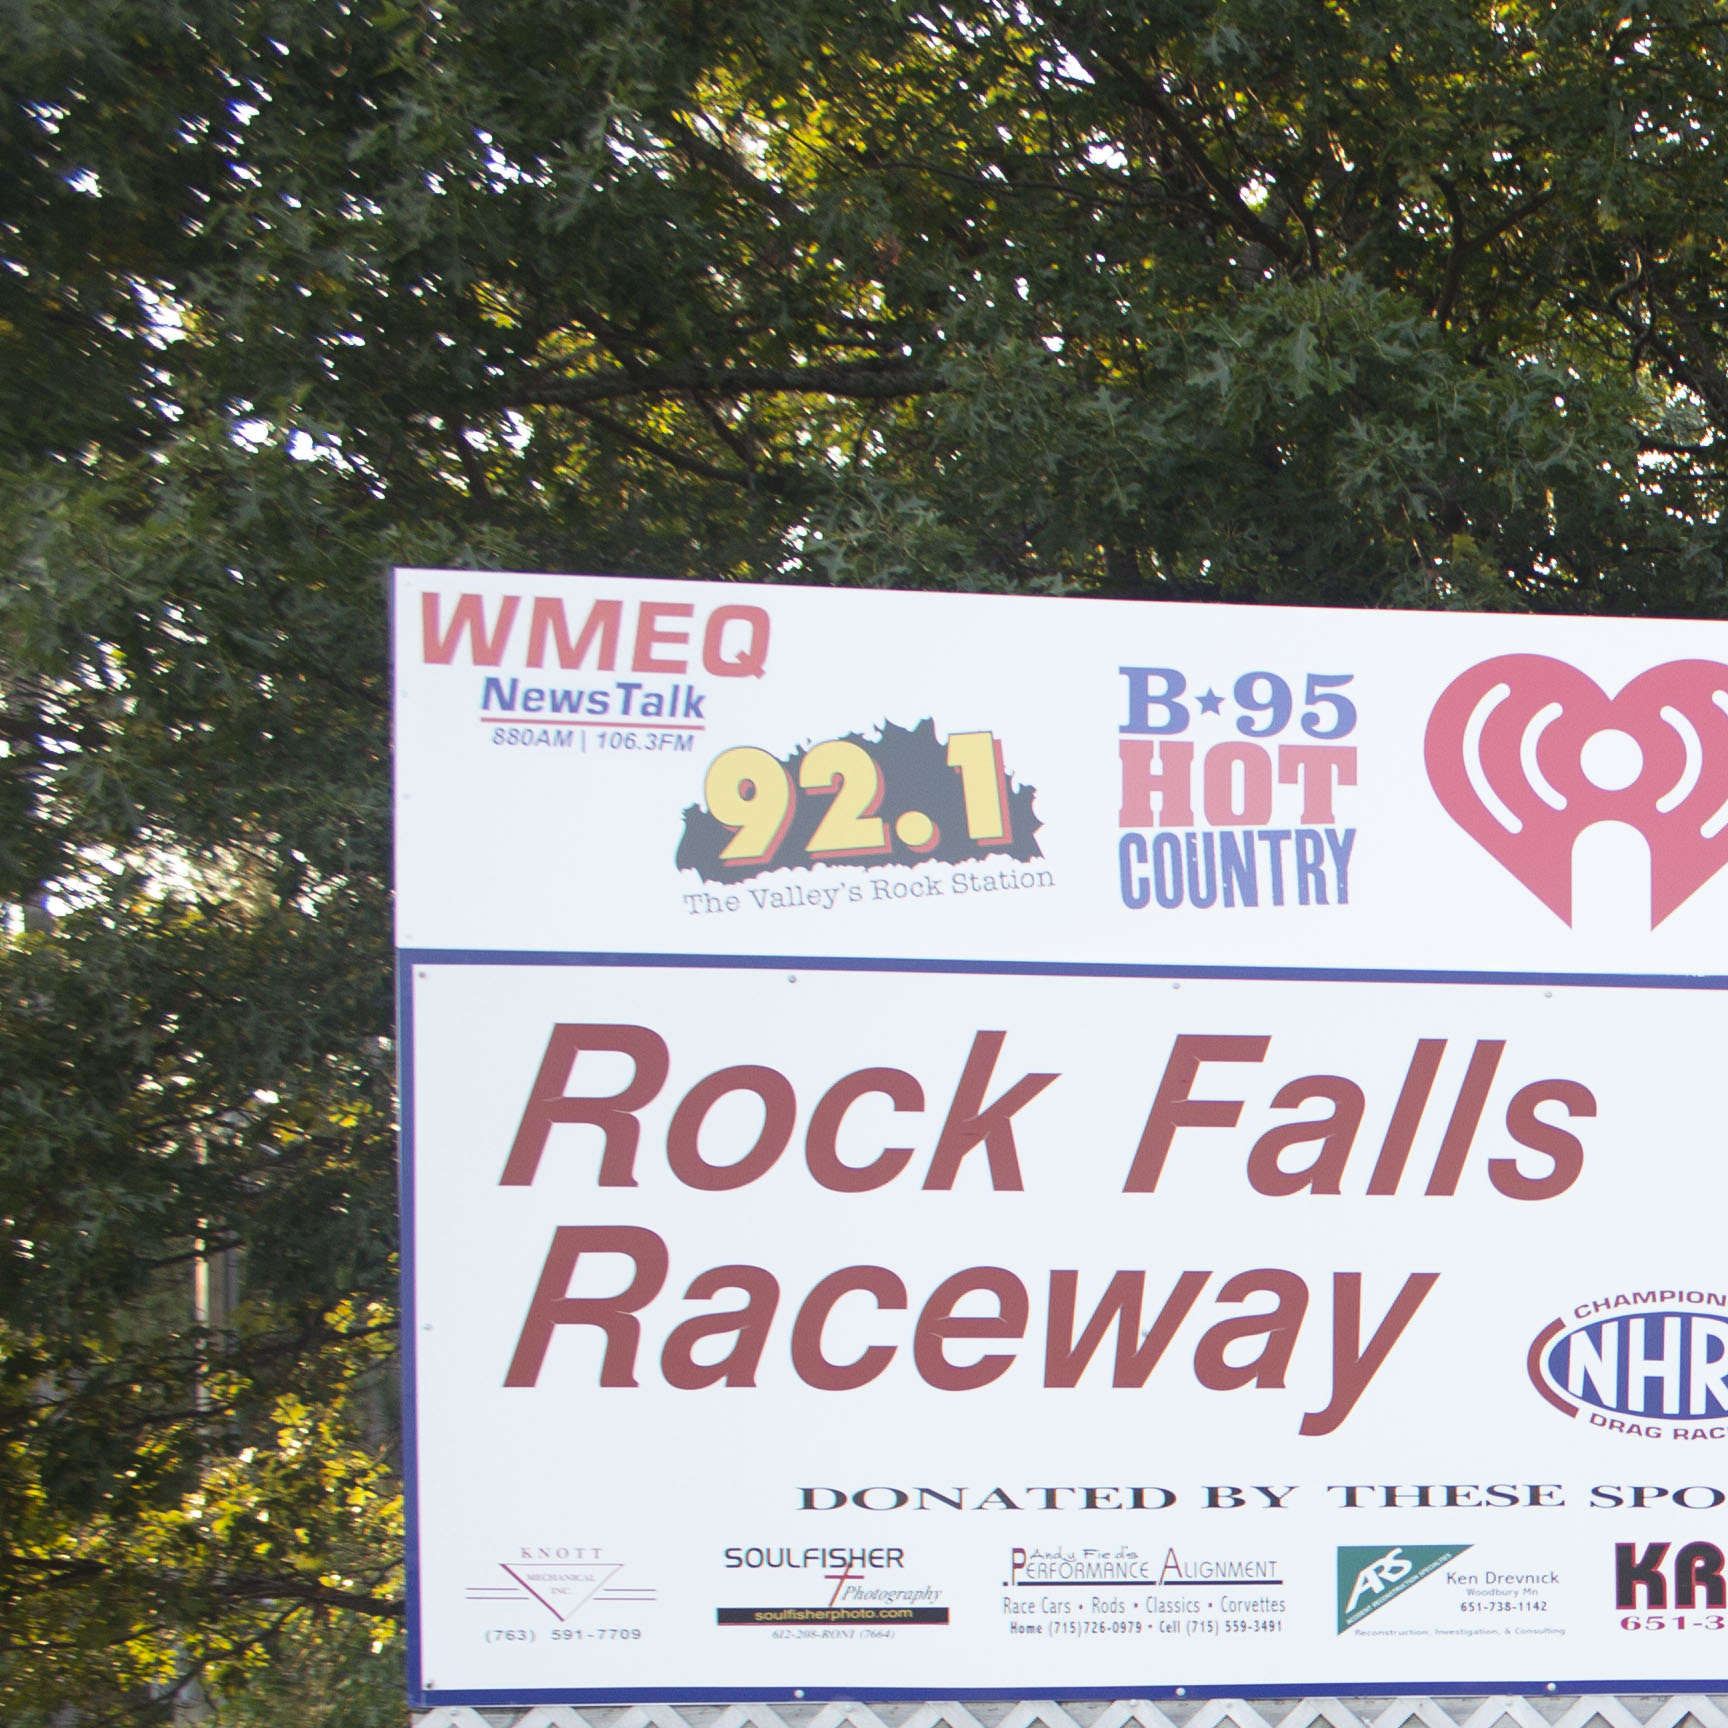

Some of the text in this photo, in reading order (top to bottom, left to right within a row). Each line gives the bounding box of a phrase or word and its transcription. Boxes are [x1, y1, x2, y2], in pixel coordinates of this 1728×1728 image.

[420, 591, 770, 679] WMEQ
[481, 676, 706, 719] NewsTalk
[492, 728, 695, 752] 880AM 106.3FM
[1119, 739, 1357, 828] HOT
[704, 730, 1010, 867] 92.1
[1119, 827, 1357, 910] COUNTRY
[684, 867, 1056, 915] The Valley's Rock Station
[497, 1022, 1599, 1201] Rock Falls
[502, 1225, 1442, 1437] Raceway
[1589, 1412, 1662, 1439] DRAG
[798, 1486, 1177, 1510] DONATED
[1201, 1484, 1301, 1508] BY
[1329, 1483, 1566, 1508] THESE
[521, 1547, 603, 1559] KNOTT
[724, 1547, 905, 1568] SOULFISHER
[1030, 1546, 1076, 1562] Andy
[1012, 1547, 1277, 1585] PERFORMANCE ALIGNMENT
[1446, 1571, 1560, 1584] Ken Drevnick
[842, 1585, 943, 1604] Photography
[1003, 1595, 1287, 1614] Race Cars Rods Classics Corvettes
[1466, 1588, 1519, 1598] Woodbury
[754, 1608, 913, 1621] soulfisherphoto.com
[1460, 1601, 1548, 1612] 651-738-1142
[485, 1628, 642, 1643] (763) 591-7709
[1010, 1622, 1043, 1634] Home
[1159, 1621, 1181, 1633] Cell
[1186, 1620, 1219, 1636] (715)
[1225, 1620, 1283, 1632] 559-3491
